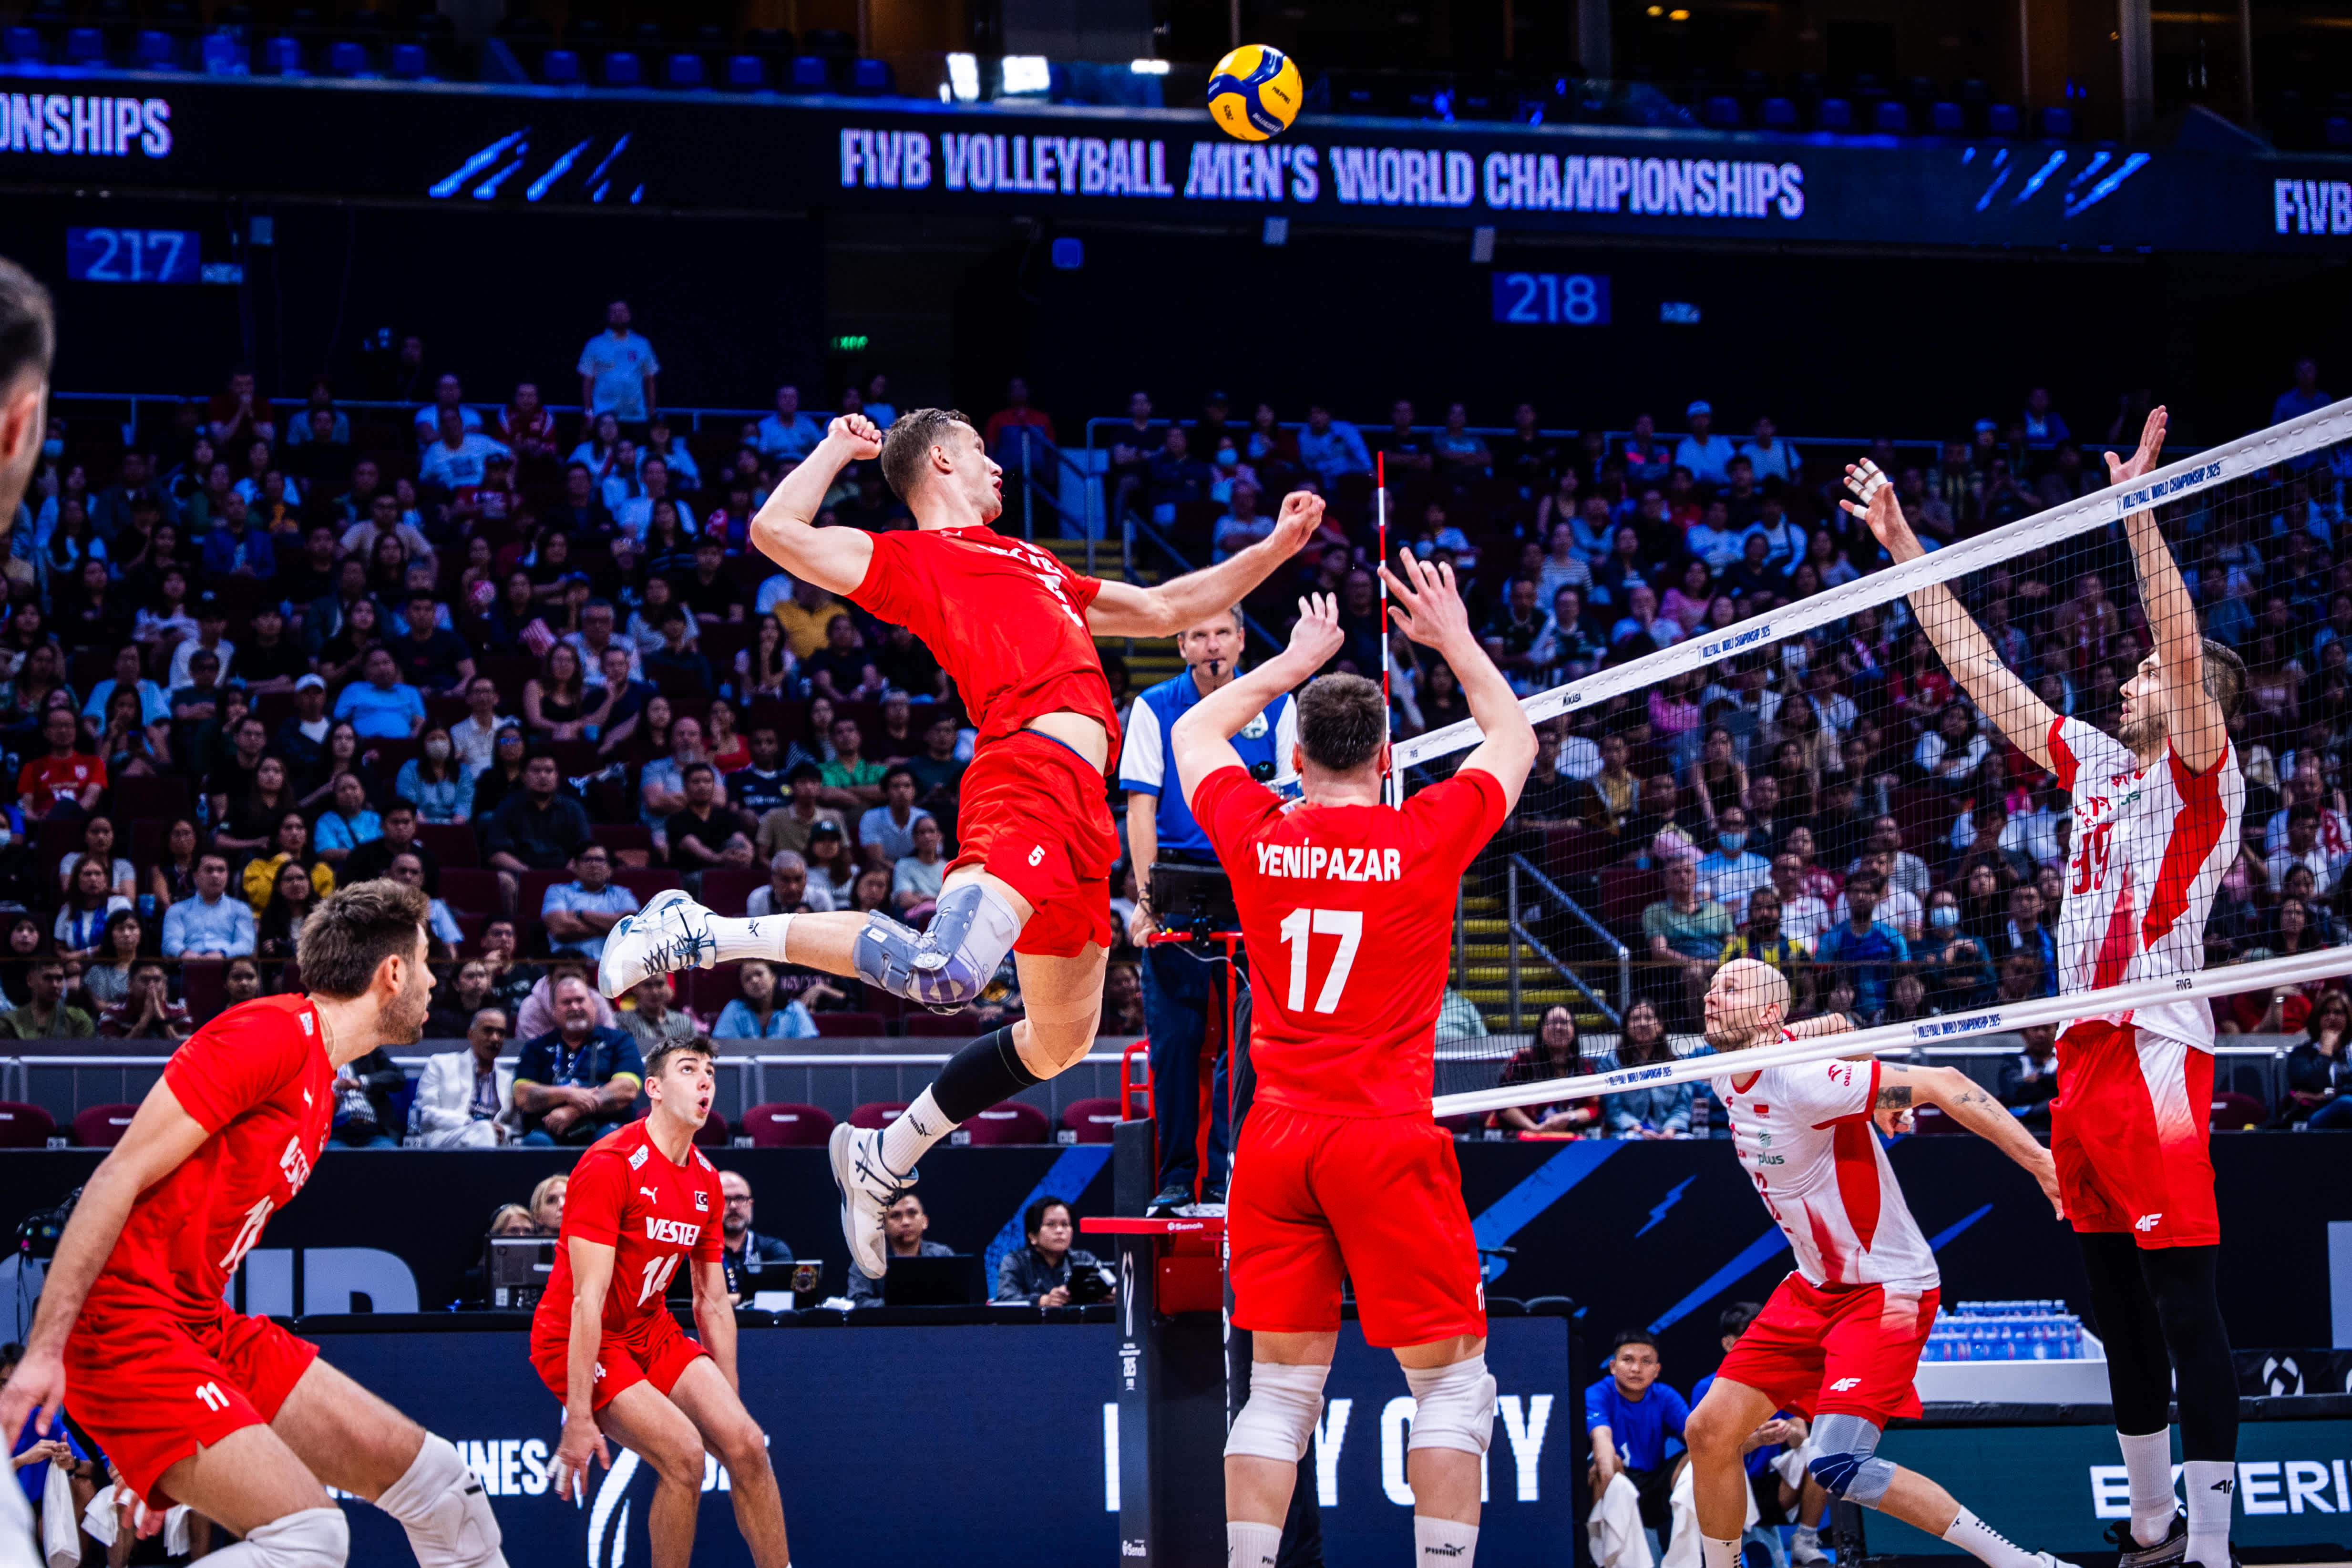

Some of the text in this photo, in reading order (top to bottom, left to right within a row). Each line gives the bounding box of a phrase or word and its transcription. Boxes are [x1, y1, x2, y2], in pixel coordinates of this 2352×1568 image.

[841, 128, 1805, 219] FIVB VOLLEYBALL MEN'S WORLD CHAMPIONSHIPS
[2274, 178, 2352, 235] FIVB
[84, 228, 185, 281] 217
[1505, 273, 1598, 323] 218
[2123, 461, 2220, 510] VOLLEYBALL WORLD CHAMPIONSHIP 2025
[1562, 693, 1582, 707] MIKASA
[1028, 844, 1046, 866] 5
[1256, 837, 1401, 882] YENİPAZAR
[1280, 907, 1363, 1014] 17
[2176, 978, 2193, 991] FIVB
[1917, 1024, 1941, 1038] VOLLEYBALL
[1941, 1021, 1957, 1035] WORLD
[908, 1113, 924, 1136] PUMA
[1757, 1151, 1785, 1167] plus
[219, 1195, 275, 1274] 11
[2135, 1213, 2162, 1232] 4F
[593, 1362, 606, 1384] 4
[1829, 1377, 1862, 1392] 4F
[195, 1382, 230, 1412] 11
[1381, 1394, 1555, 1506] CY
